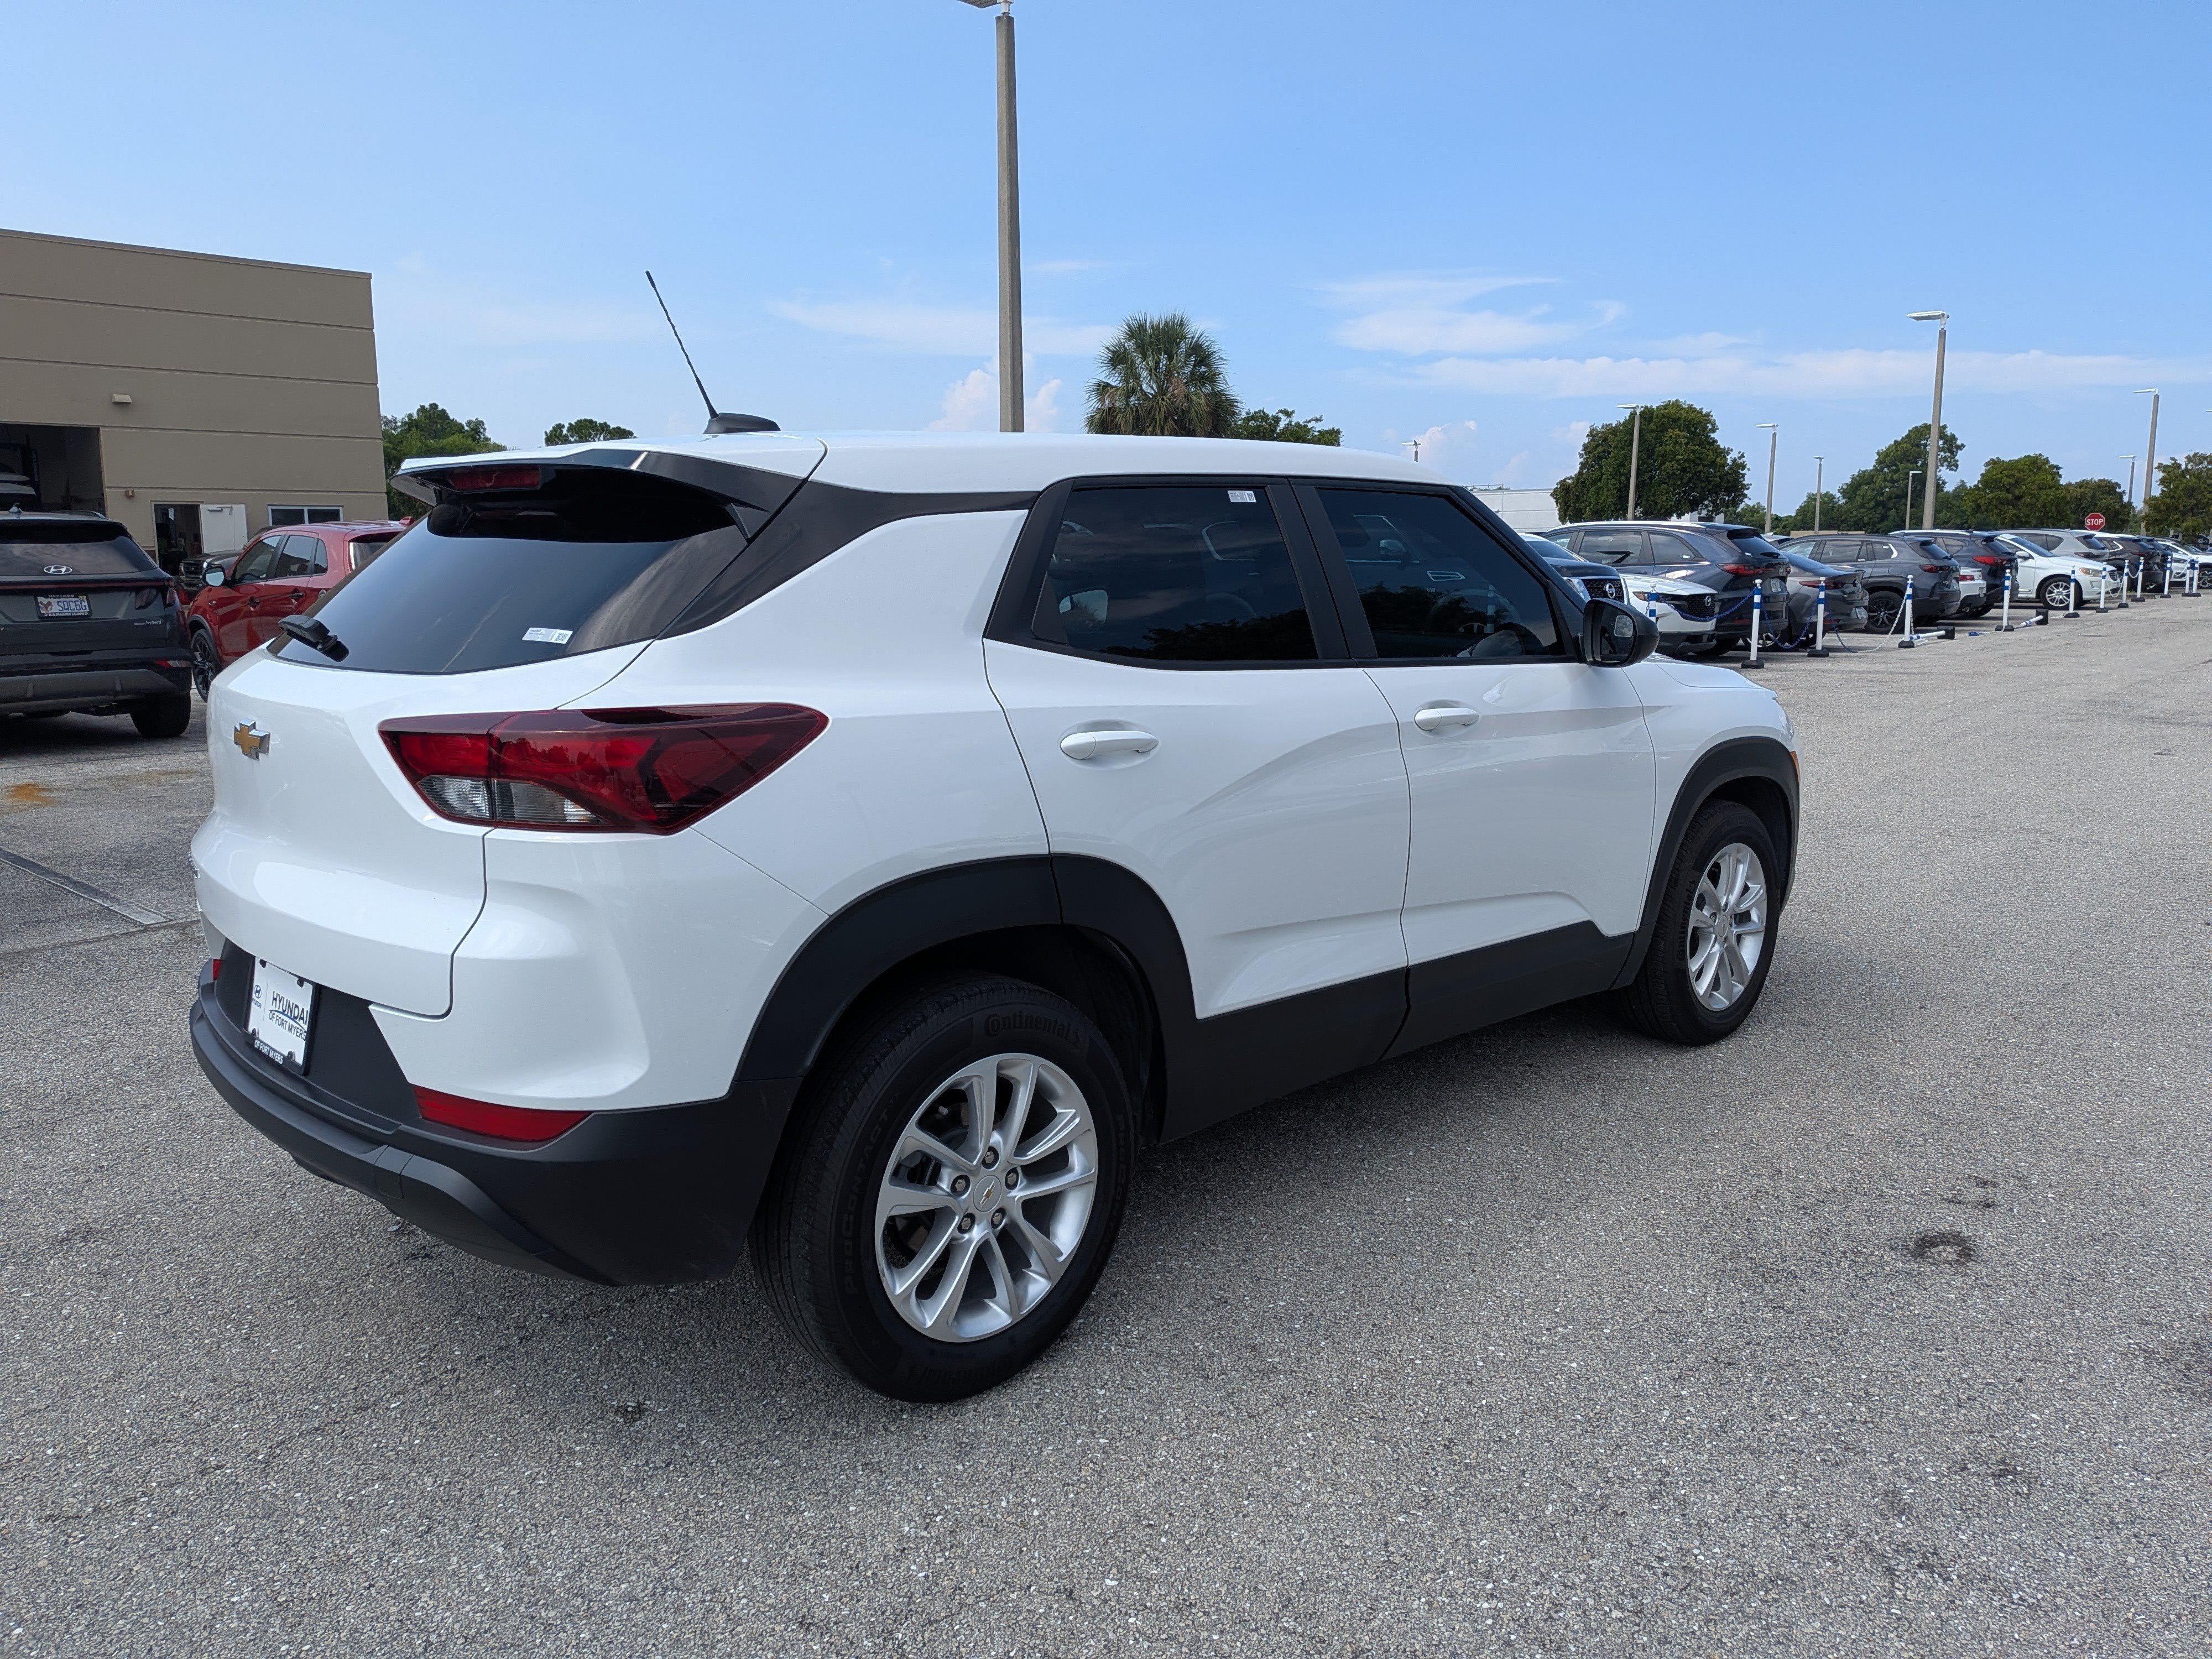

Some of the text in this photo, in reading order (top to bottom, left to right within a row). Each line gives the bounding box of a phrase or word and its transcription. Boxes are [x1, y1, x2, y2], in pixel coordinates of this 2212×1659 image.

[56, 599, 87, 612] SQC6G
[272, 990, 309, 1025] HYUNDAI
[269, 1010, 307, 1041] OF FORT MYERS
[984, 1010, 1071, 1040] Continental
[254, 1039, 284, 1065] OF FORT MYERS
